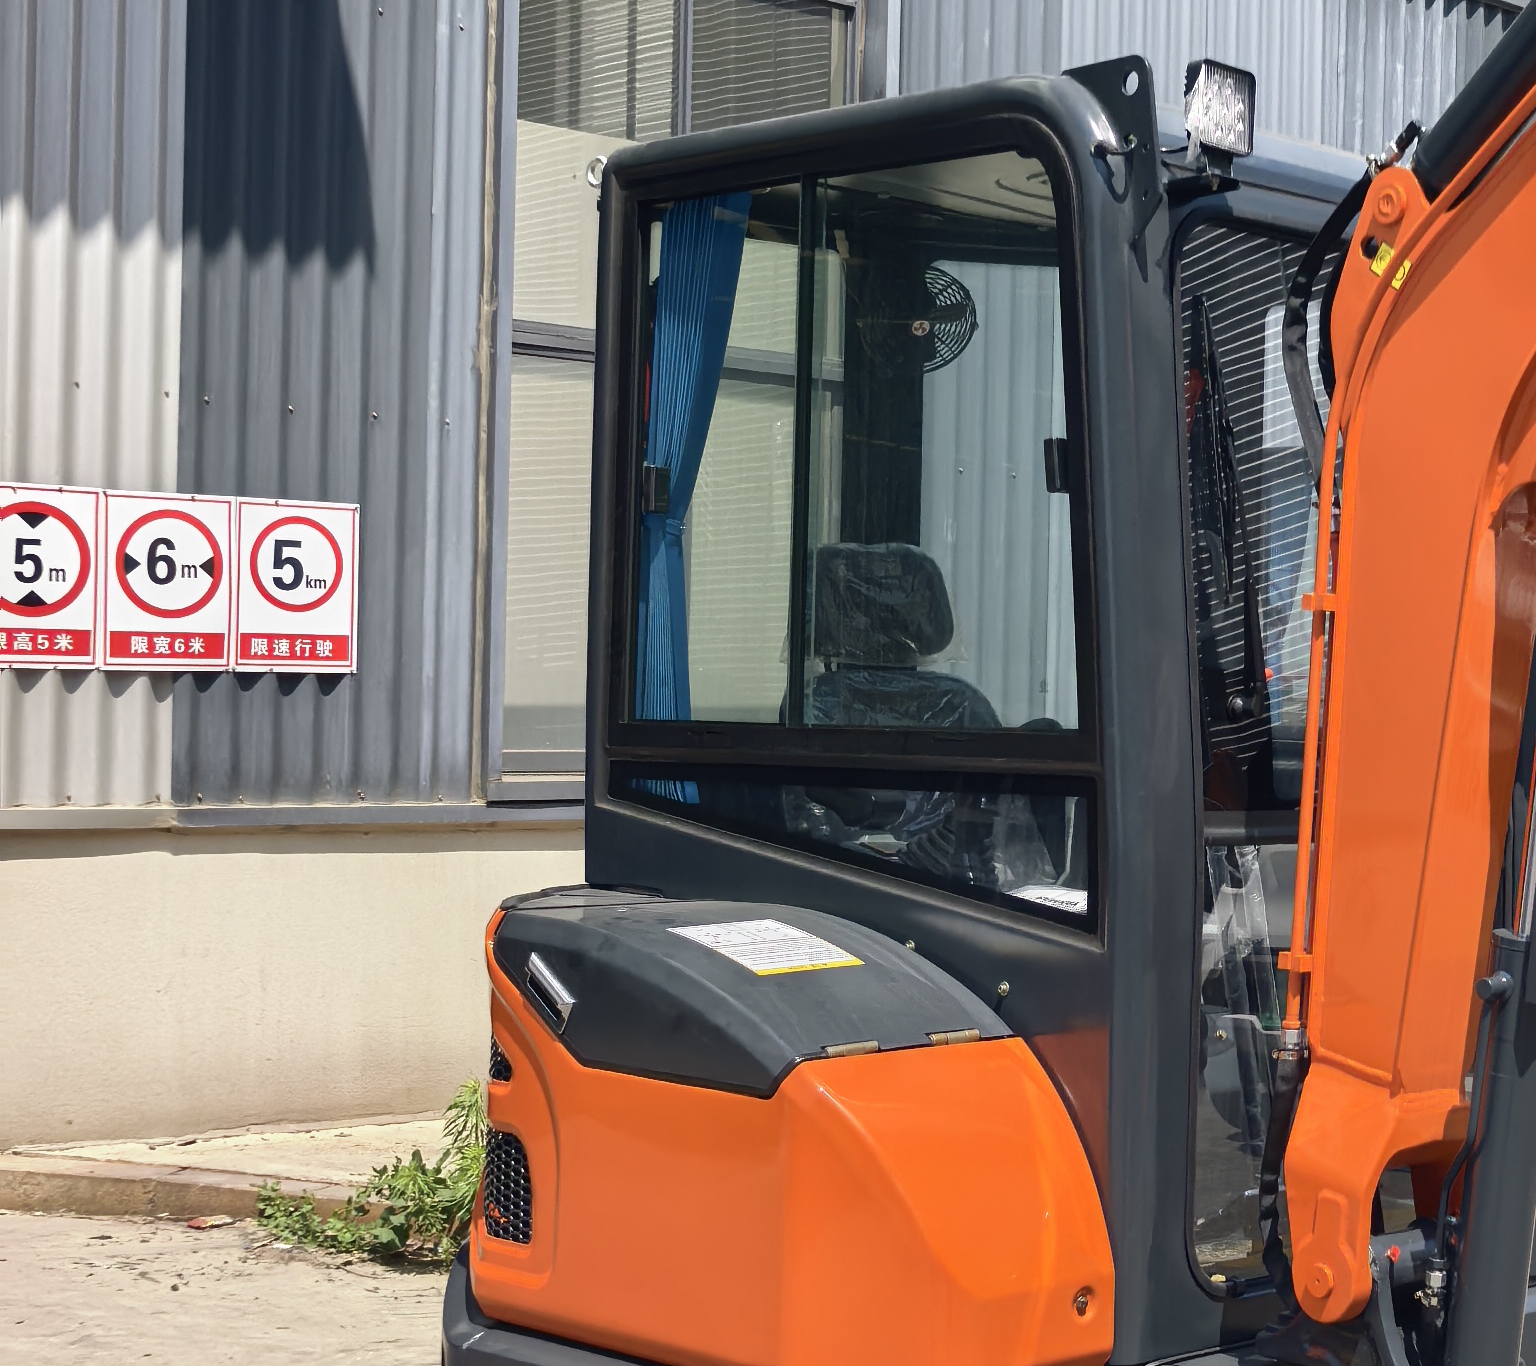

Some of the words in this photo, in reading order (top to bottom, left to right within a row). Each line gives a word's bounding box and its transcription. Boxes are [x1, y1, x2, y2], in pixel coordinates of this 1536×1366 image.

[130, 636, 206, 655] 限宽6米
[251, 638, 333, 657] 限速行驶
